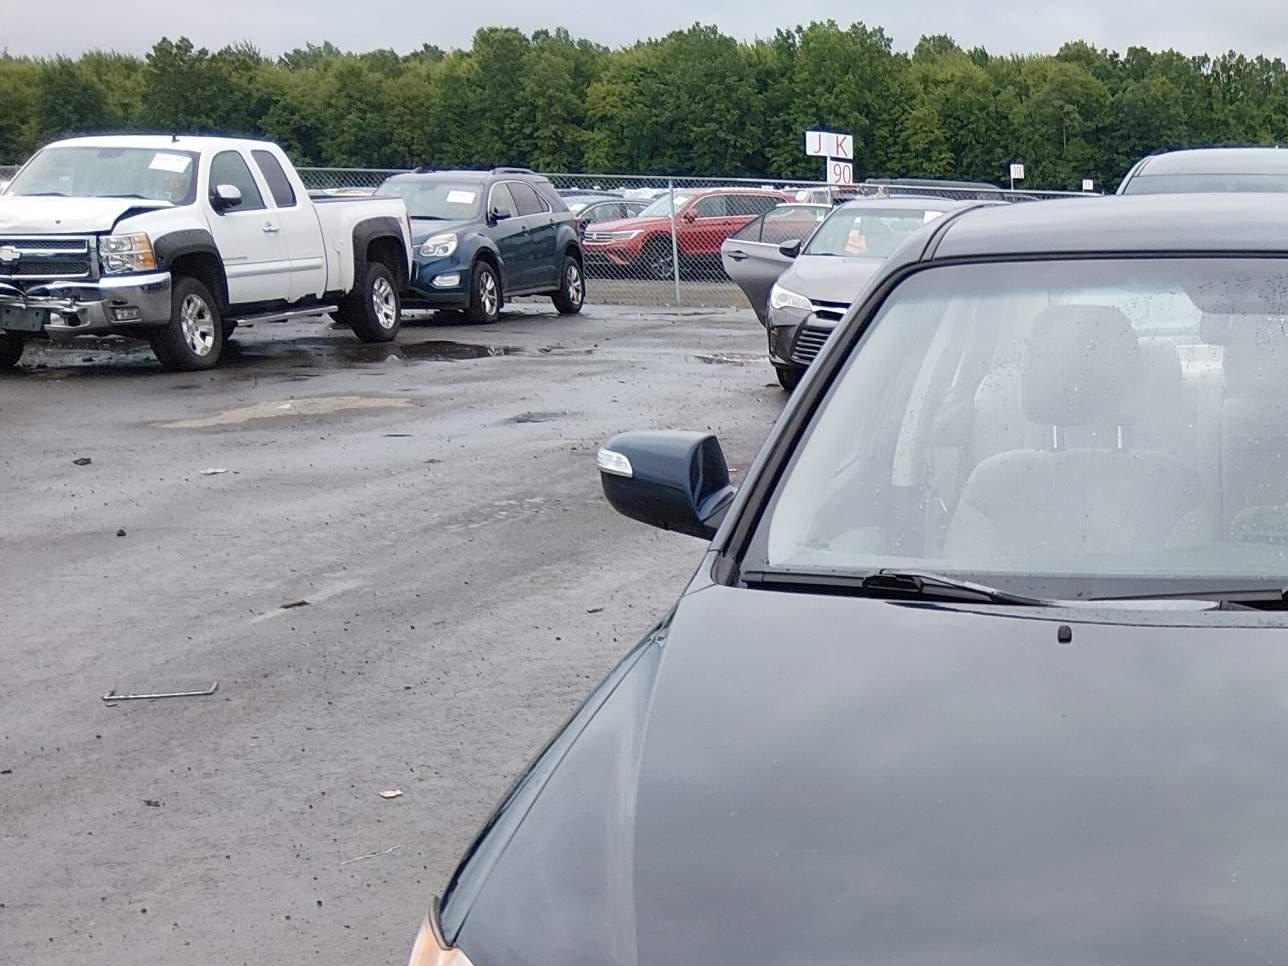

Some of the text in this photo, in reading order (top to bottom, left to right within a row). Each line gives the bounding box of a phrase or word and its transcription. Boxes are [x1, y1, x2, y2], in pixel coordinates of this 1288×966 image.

[813, 133, 848, 157] J K
[833, 163, 851, 184] 90
